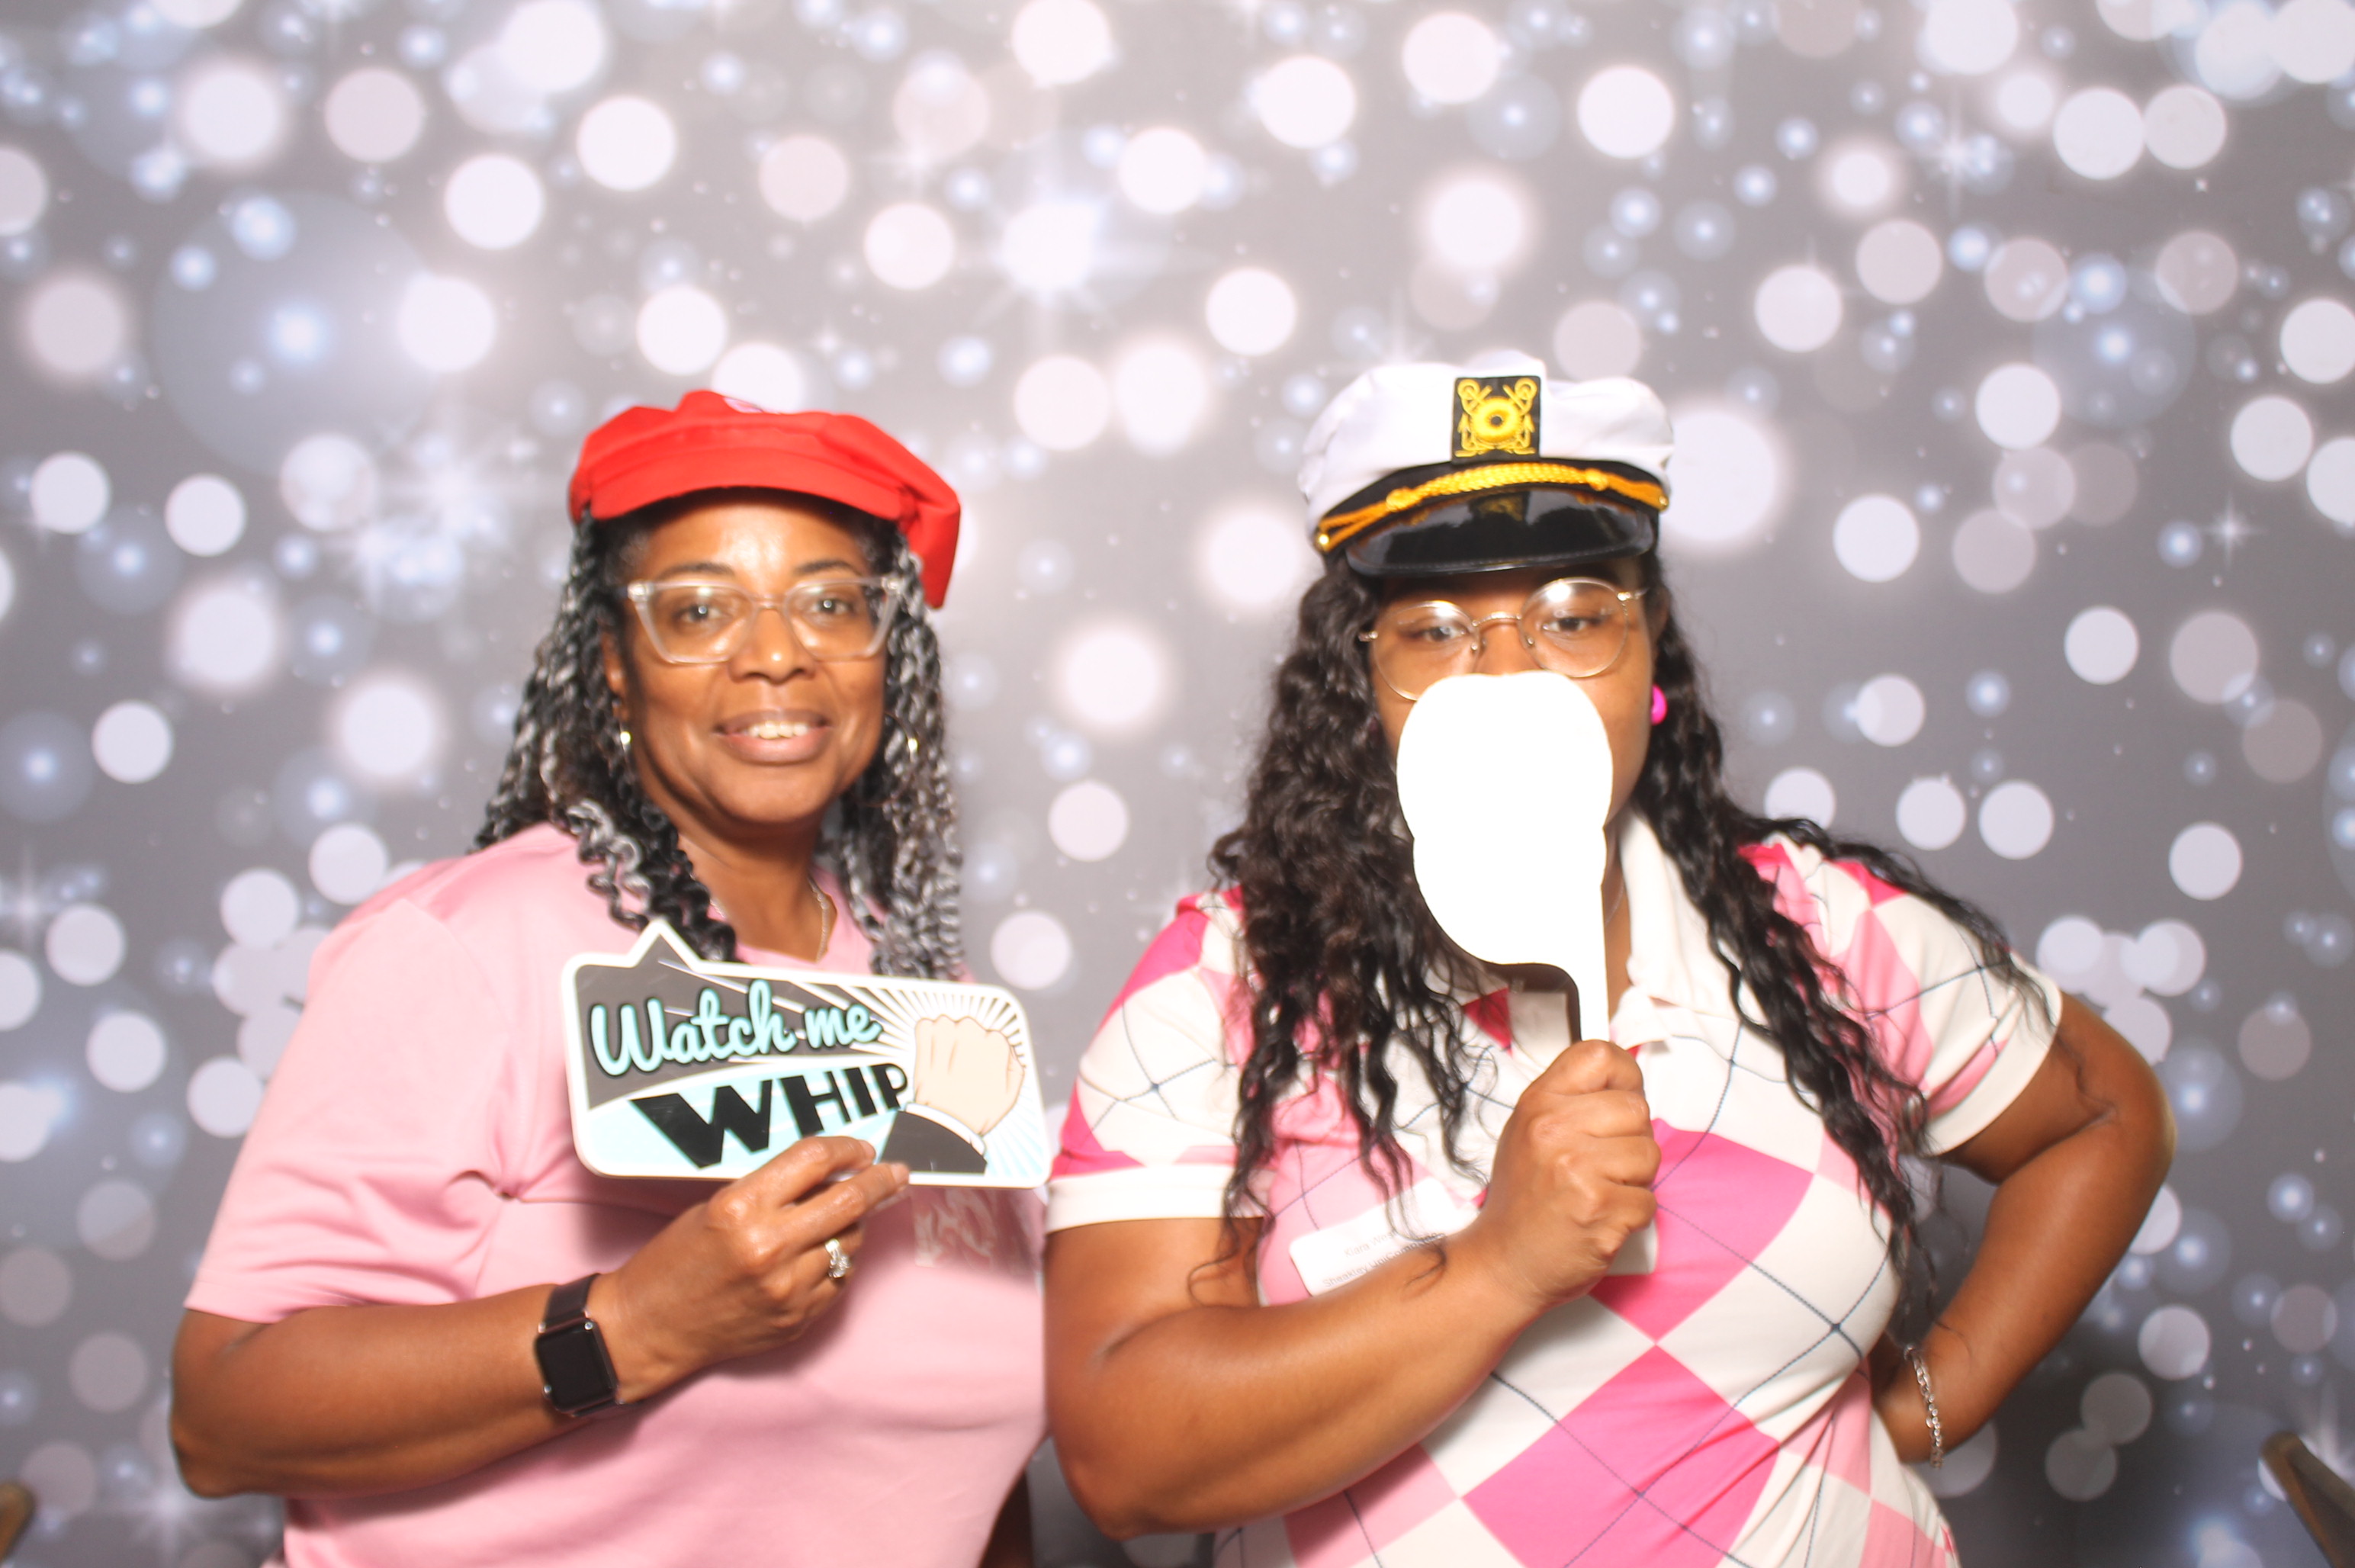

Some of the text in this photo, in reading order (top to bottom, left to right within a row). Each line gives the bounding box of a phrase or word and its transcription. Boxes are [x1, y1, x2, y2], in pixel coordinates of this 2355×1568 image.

[591, 980, 884, 1075] Watch me
[629, 1063, 908, 1169] WHIP
